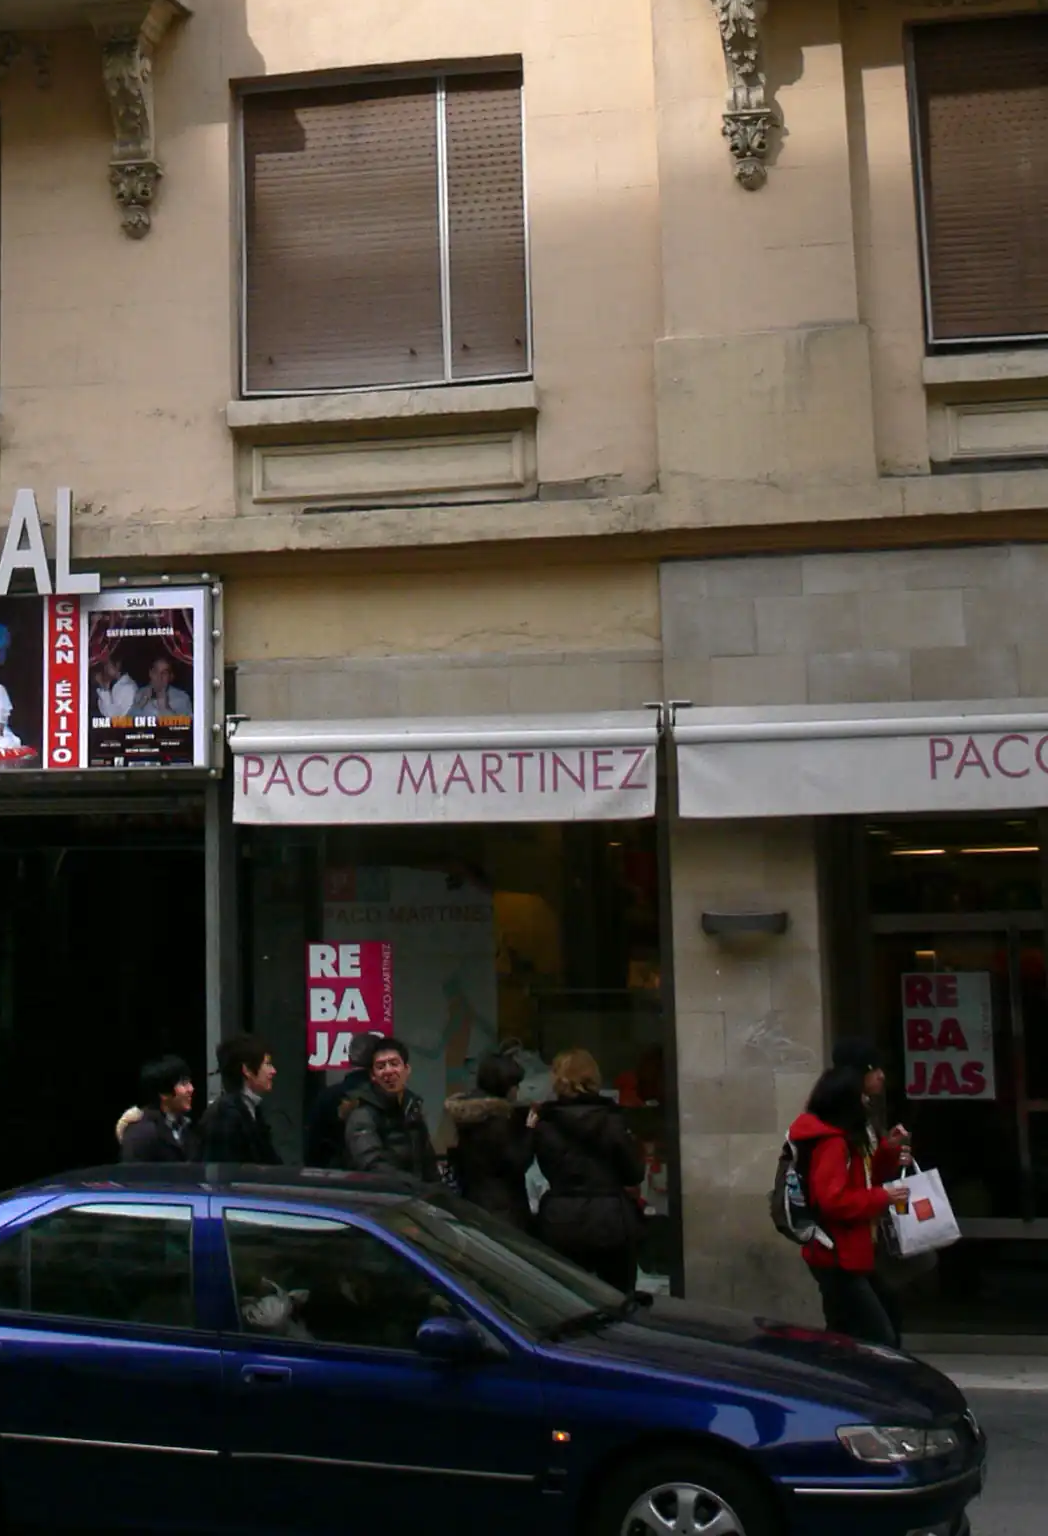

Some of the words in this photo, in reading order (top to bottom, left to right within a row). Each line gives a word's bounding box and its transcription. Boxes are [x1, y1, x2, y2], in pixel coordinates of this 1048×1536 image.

[127, 598, 147, 607] SALA
[55, 601, 74, 664] GRAN
[53, 680, 73, 763] ÉXITO
[92, 717, 111, 729] UNA
[147, 716, 157, 727] EL
[241, 754, 372, 796] PACO
[397, 748, 649, 795] MARTINEZ
[309, 944, 361, 978] RE
[309, 988, 371, 1022] BA
[904, 974, 959, 1008] RE
[308, 1031, 385, 1067] JA
[906, 1018, 969, 1052] BA
[906, 1061, 986, 1096] JAS
